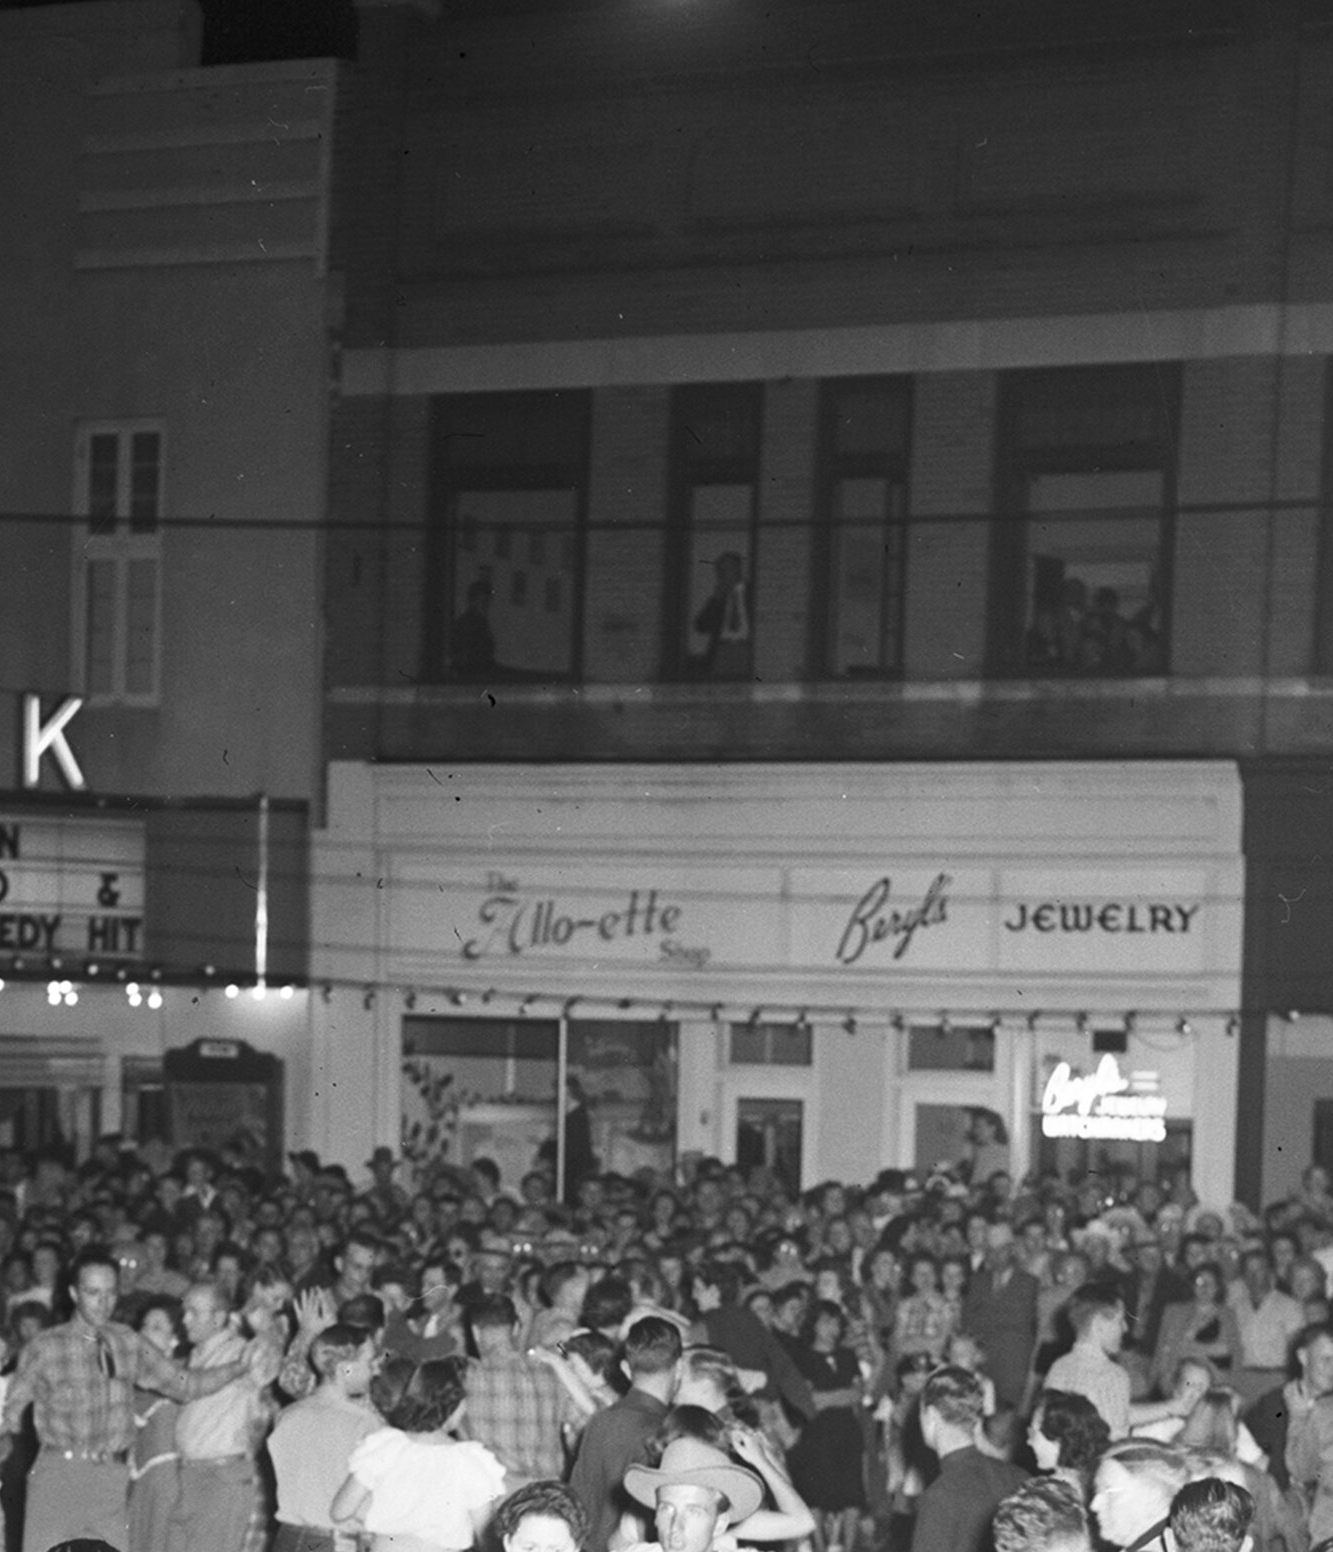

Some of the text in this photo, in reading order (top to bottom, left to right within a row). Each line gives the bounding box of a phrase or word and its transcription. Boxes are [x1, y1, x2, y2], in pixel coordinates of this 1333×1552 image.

[98, 872, 120, 907] &
[88, 915, 141, 951] HIT
[1004, 903, 1199, 933] JEWELRY
